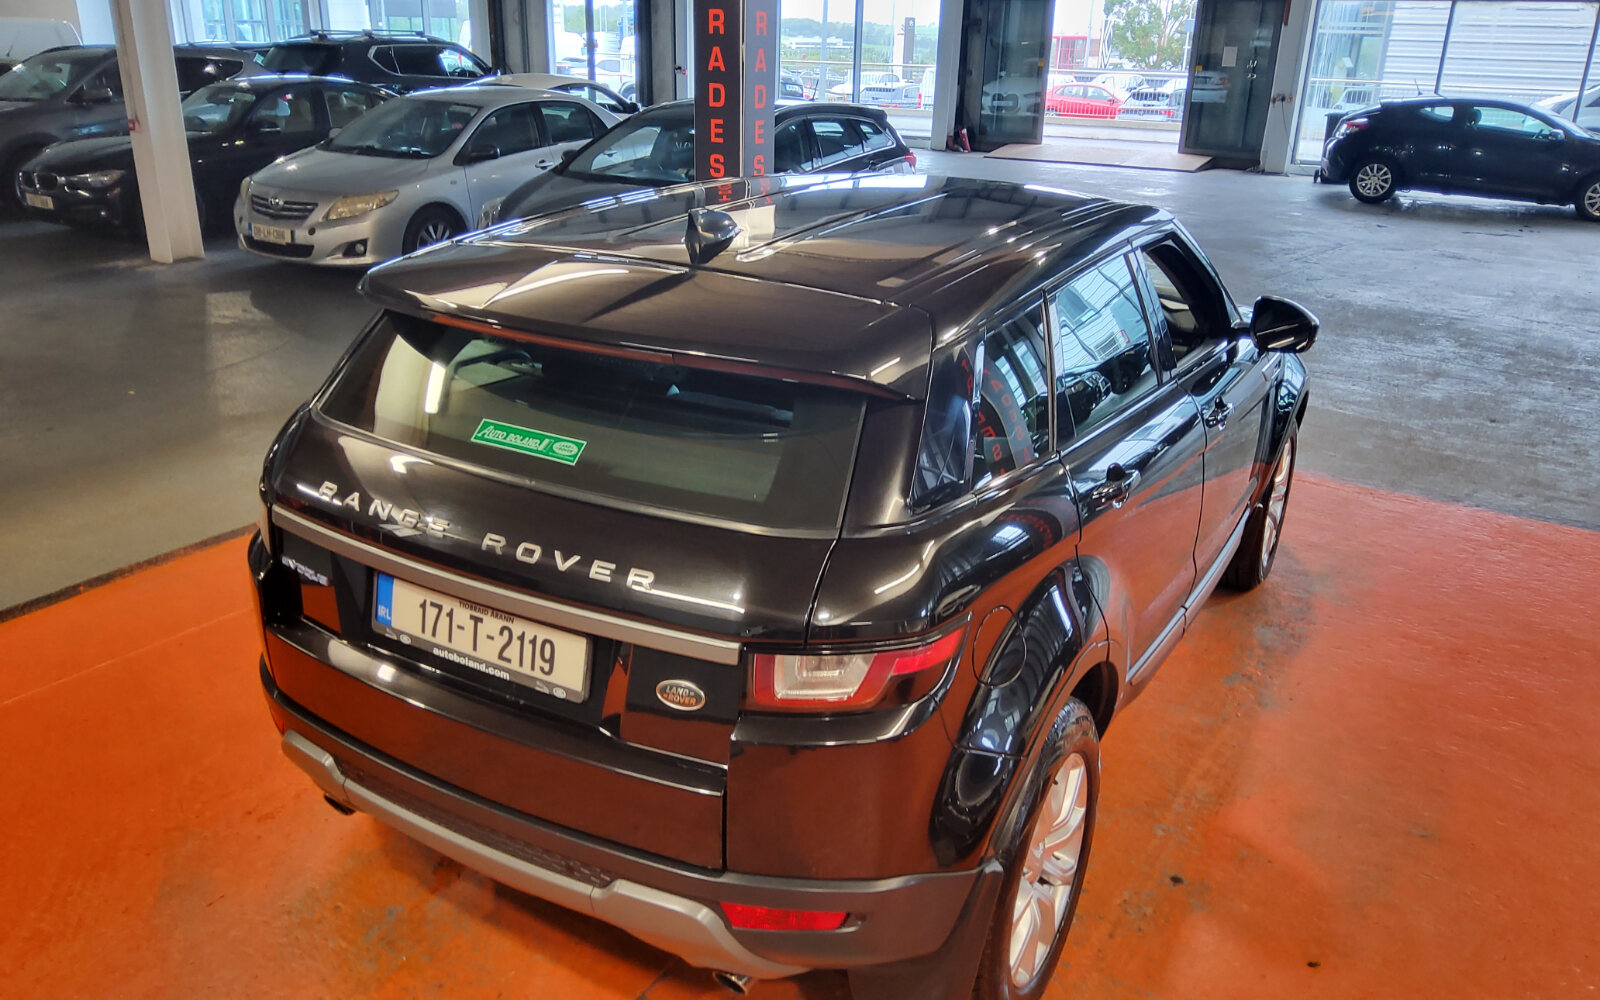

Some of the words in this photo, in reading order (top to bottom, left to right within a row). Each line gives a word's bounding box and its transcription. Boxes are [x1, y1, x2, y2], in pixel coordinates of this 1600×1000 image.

[318, 480, 451, 539] RANGE
[481, 532, 656, 590] ROVER
[377, 604, 392, 620] IRL
[459, 600, 489, 616] TIOBRAID
[419, 598, 556, 676] 171-T-2119
[433, 647, 510, 681] autoboland.com
